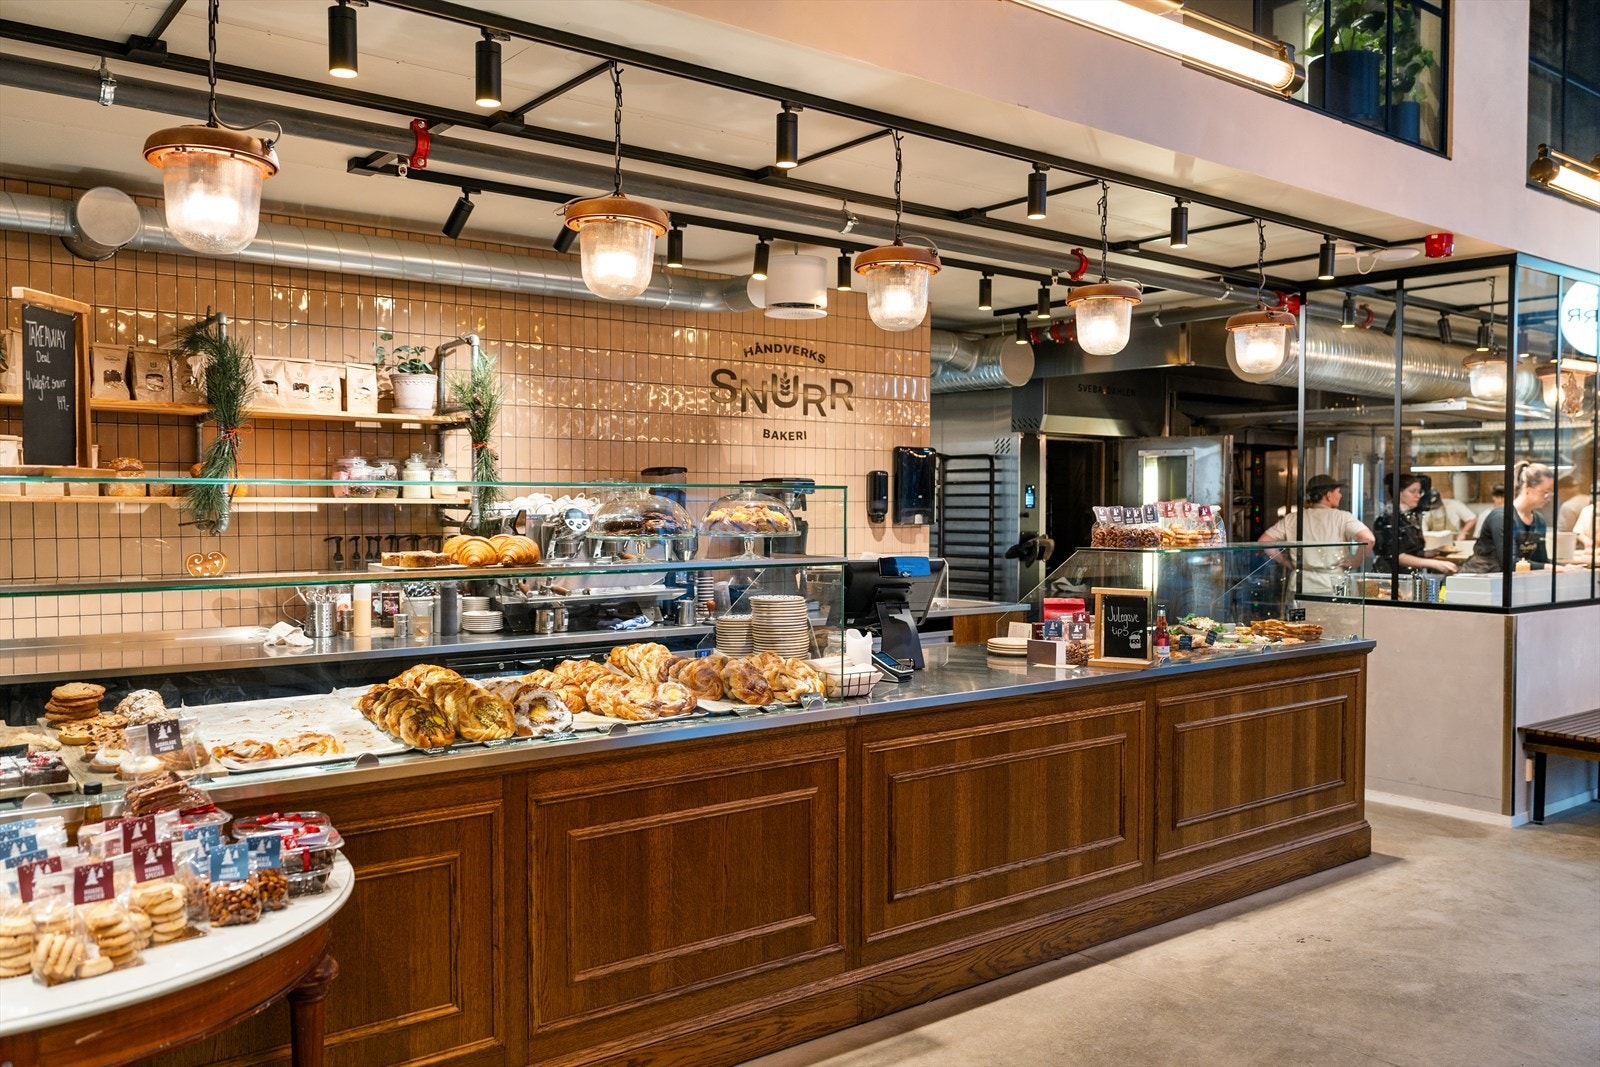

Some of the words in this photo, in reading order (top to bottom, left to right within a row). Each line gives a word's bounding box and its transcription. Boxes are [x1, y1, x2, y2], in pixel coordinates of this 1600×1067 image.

[25, 319, 66, 350] TAKEAWAY
[36, 350, 51, 364] Deal
[743, 342, 826, 364] HÅNDVERKS
[710, 368, 854, 417] SNURR
[762, 428, 807, 441] BAKERI
[1106, 605, 1140, 629] Julegave
[1111, 626, 1129, 637] tips
